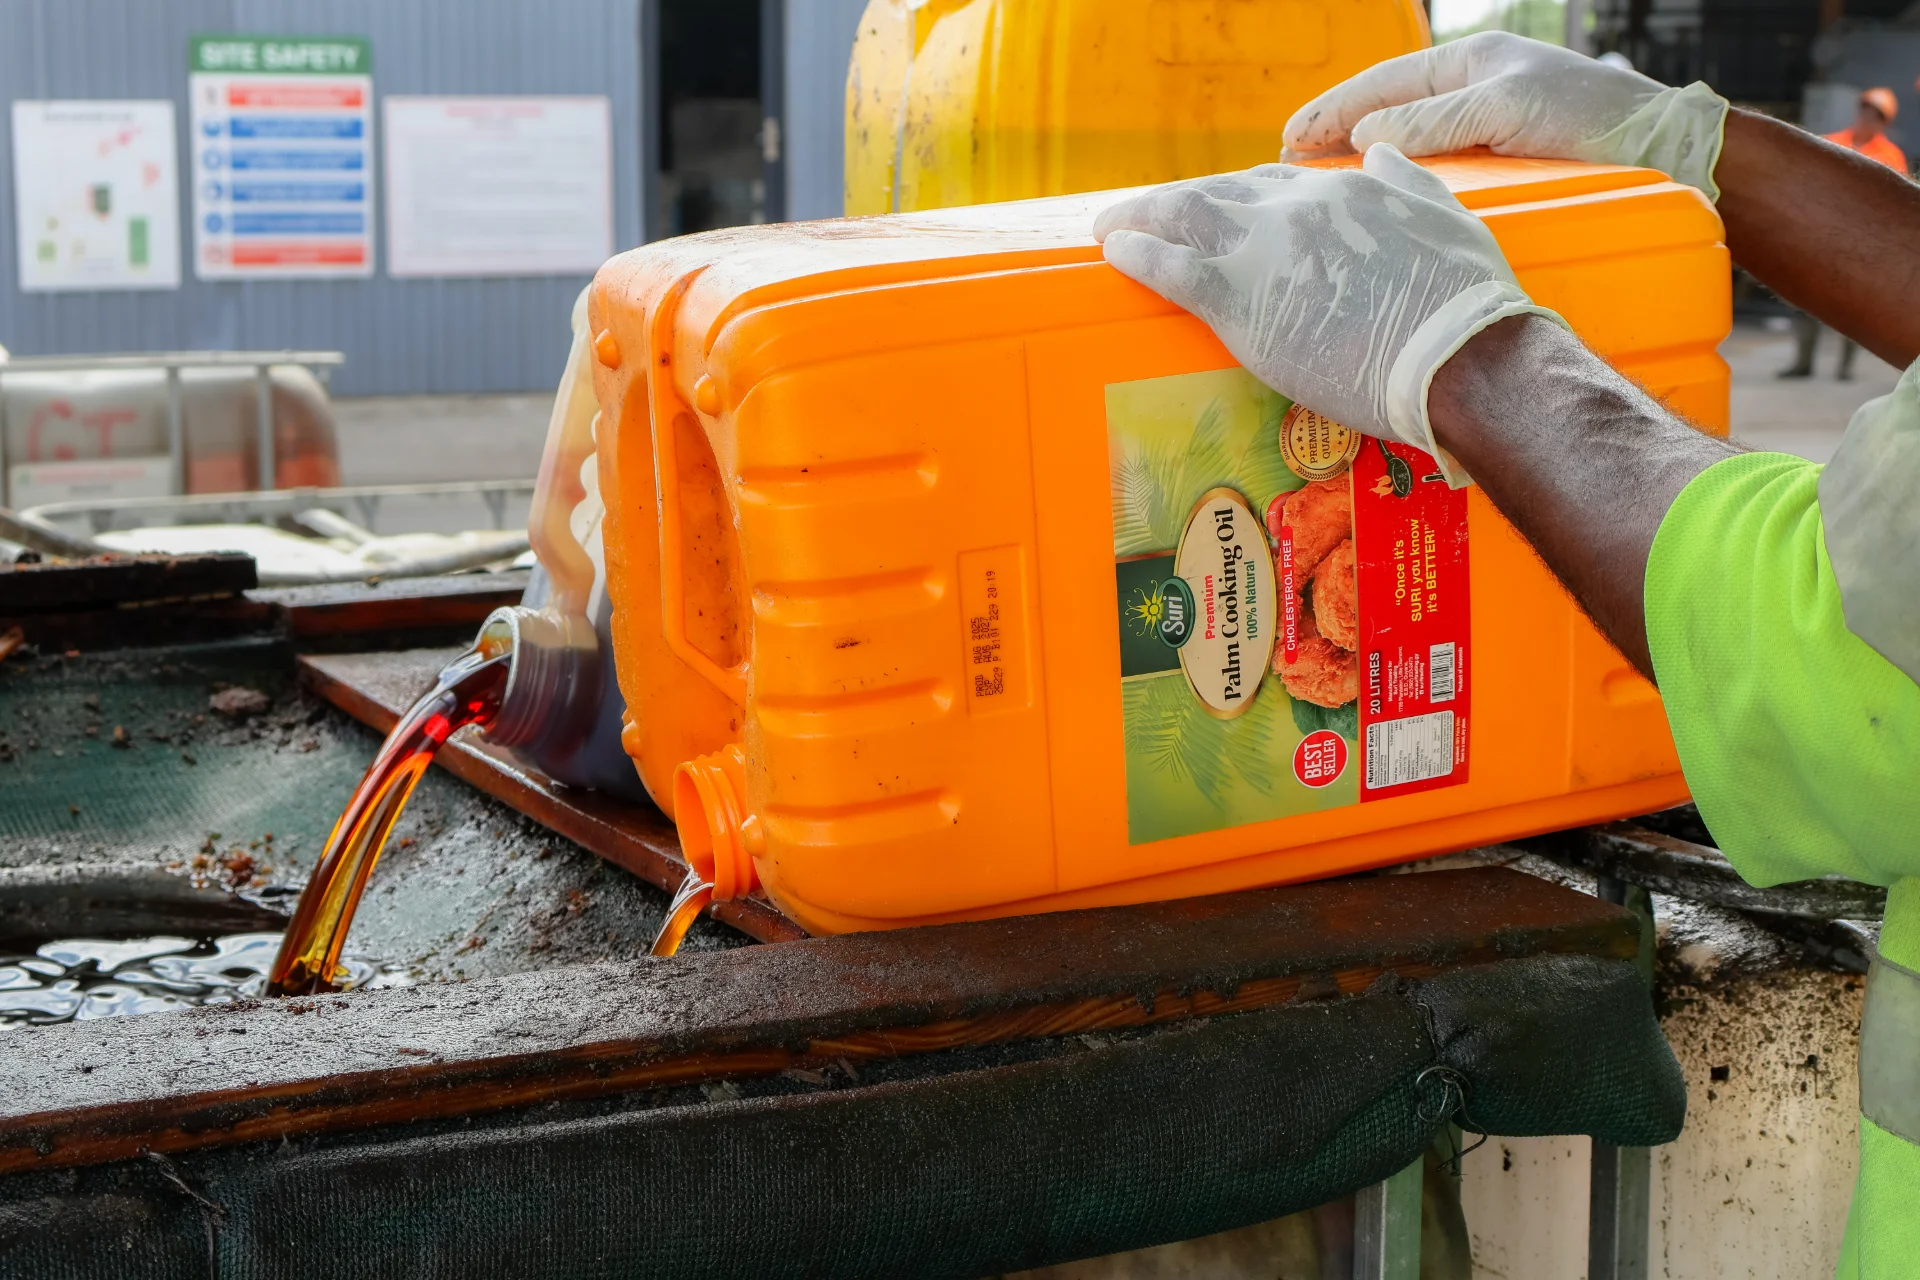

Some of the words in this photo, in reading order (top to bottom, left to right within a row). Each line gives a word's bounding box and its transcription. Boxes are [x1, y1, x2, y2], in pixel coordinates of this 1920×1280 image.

[200, 41, 257, 69] SITE
[261, 42, 359, 71] SAFETY
[1308, 410, 1318, 463] PREMIUM
[1321, 416, 1331, 460] QUALIT
[1214, 506, 1235, 542] Oil
[1410, 519, 1420, 556] know
[1283, 538, 1292, 568] FREE
[1244, 560, 1256, 604] Natural
[1412, 560, 1423, 585] you
[1204, 575, 1216, 640] Premium
[1219, 544, 1243, 639] Cooking
[1411, 589, 1422, 622] SURI
[989, 604, 998, 621] 229
[1161, 594, 1185, 636] Suri
[1246, 607, 1258, 641] 100%
[1284, 570, 1296, 651] CHOLESTEROL
[971, 617, 981, 641] 2025
[973, 646, 982, 664] AUG
[982, 645, 992, 663] AUG
[1222, 640, 1242, 702] Palm
[974, 674, 984, 697] PROD
[984, 679, 994, 696] EXP
[1369, 652, 1380, 697] LITRES
[1370, 700, 1380, 714] 20
[1304, 743, 1322, 779] BEST
[1324, 739, 1336, 776] SELLER
